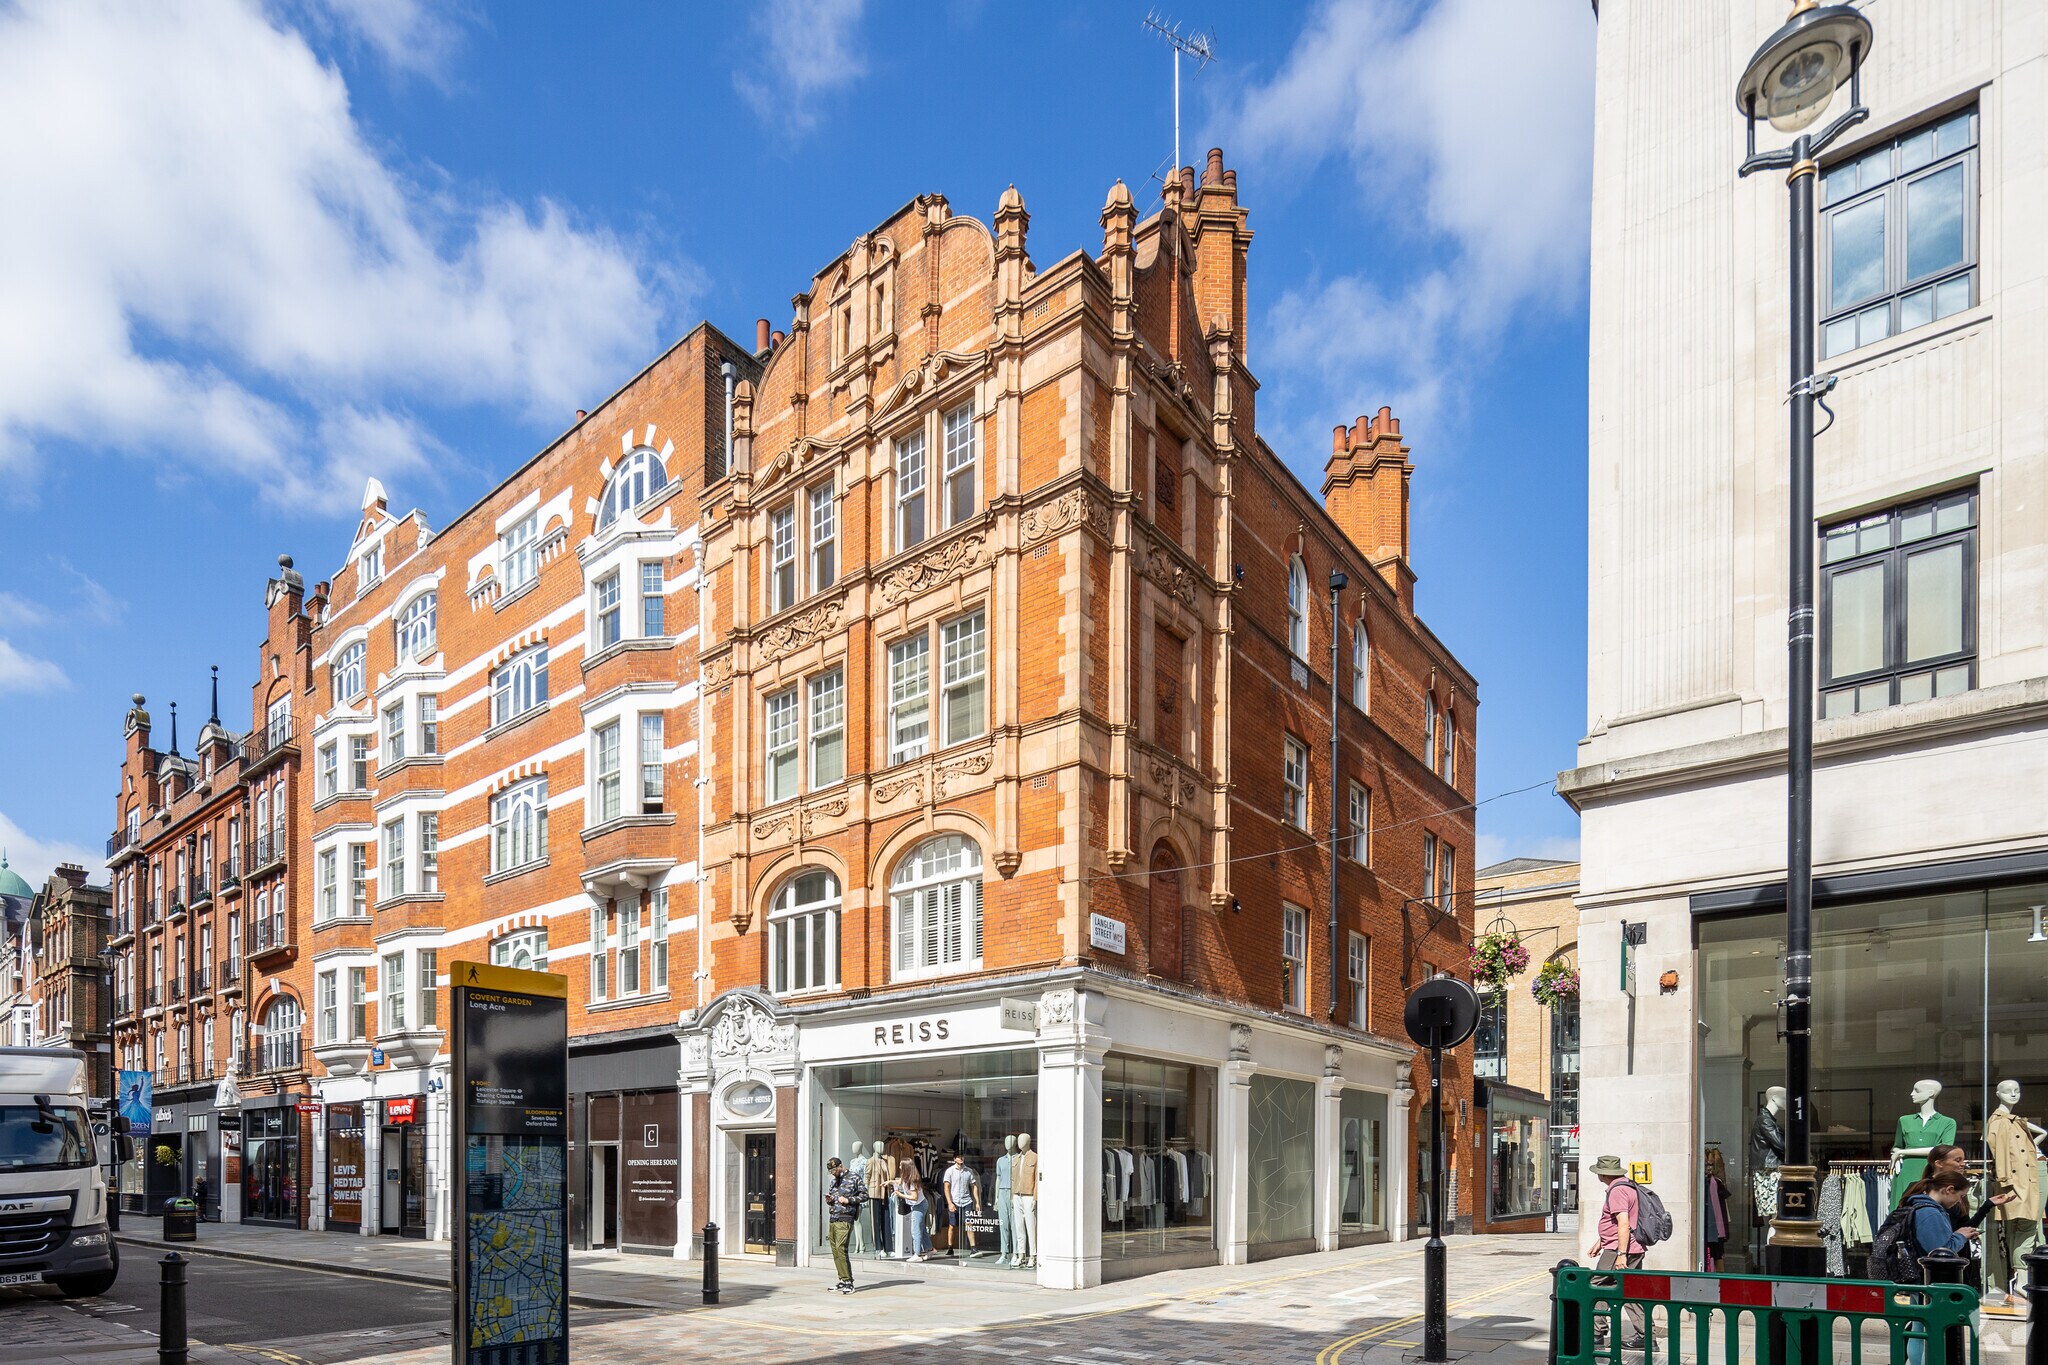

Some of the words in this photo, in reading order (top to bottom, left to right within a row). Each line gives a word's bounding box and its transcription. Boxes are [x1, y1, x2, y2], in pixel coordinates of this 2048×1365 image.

[1094, 917, 1115, 930] LANGLEY
[1094, 927, 1112, 939] STREET
[470, 993, 500, 1003] COVENT
[502, 996, 532, 1006] GARDEN
[470, 1001, 487, 1010] Long
[489, 1003, 506, 1011] Acre
[1005, 1008, 1033, 1021] REISS
[874, 1019, 950, 1046] REISS
[1431, 1078, 1438, 1087] S
[647, 1129, 655, 1142] C
[333, 1165, 357, 1175] LEVI'S
[333, 1178, 348, 1188] RED
[348, 1177, 363, 1187] TAB
[333, 1190, 363, 1200] SWEATS
[965, 1218, 1004, 1226] CONTINUES
[965, 1225, 994, 1233] INSTORE
[19, 1273, 38, 1282] GME
